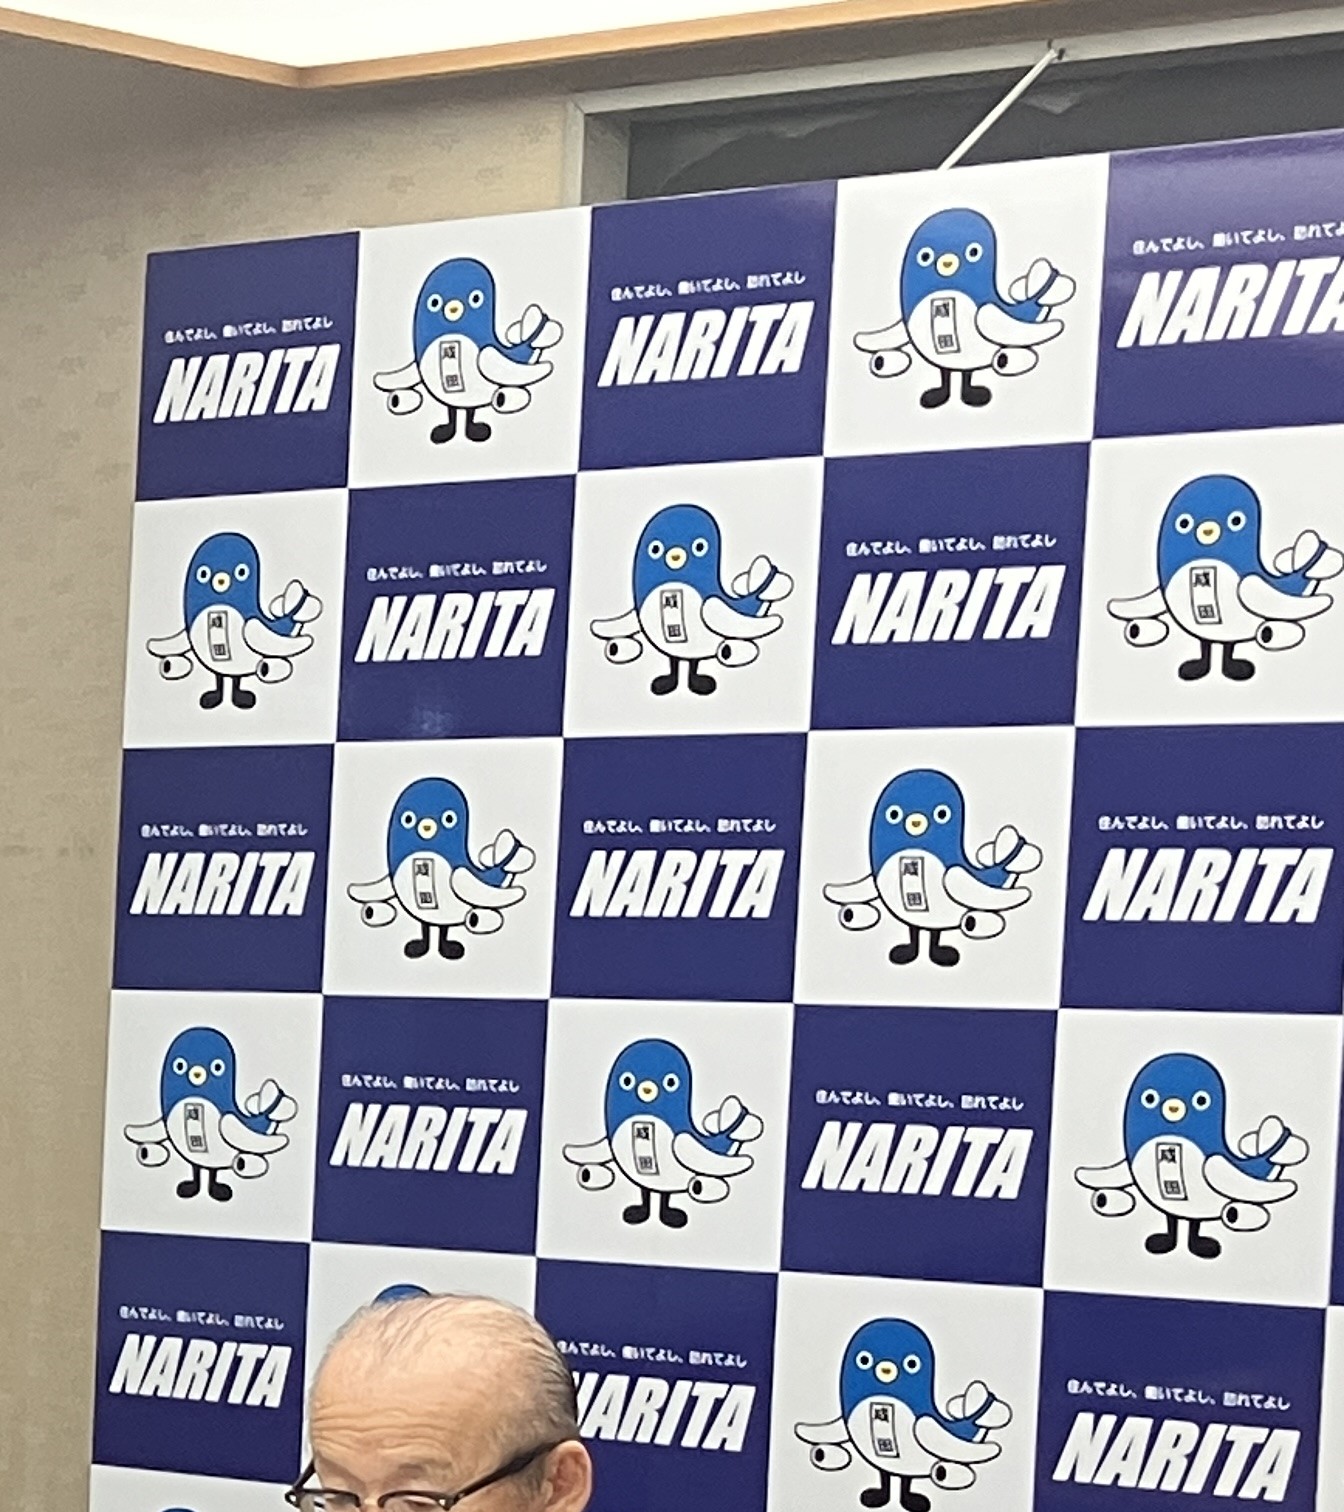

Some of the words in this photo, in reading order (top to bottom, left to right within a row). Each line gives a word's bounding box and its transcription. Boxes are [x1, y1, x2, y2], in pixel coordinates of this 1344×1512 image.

[597, 300, 815, 387] NARITA
[154, 344, 341, 424] NARITA
[354, 588, 556, 663] NARITA
[831, 565, 1066, 645] NARITA
[129, 851, 315, 916] NARITA
[569, 849, 786, 918] NARITA
[1082, 848, 1334, 923] NARITA
[329, 1102, 528, 1175] NARITA
[801, 1120, 1034, 1200] NARITA
[109, 1333, 292, 1408] NARITA
[1052, 1412, 1301, 1502] NARITA
